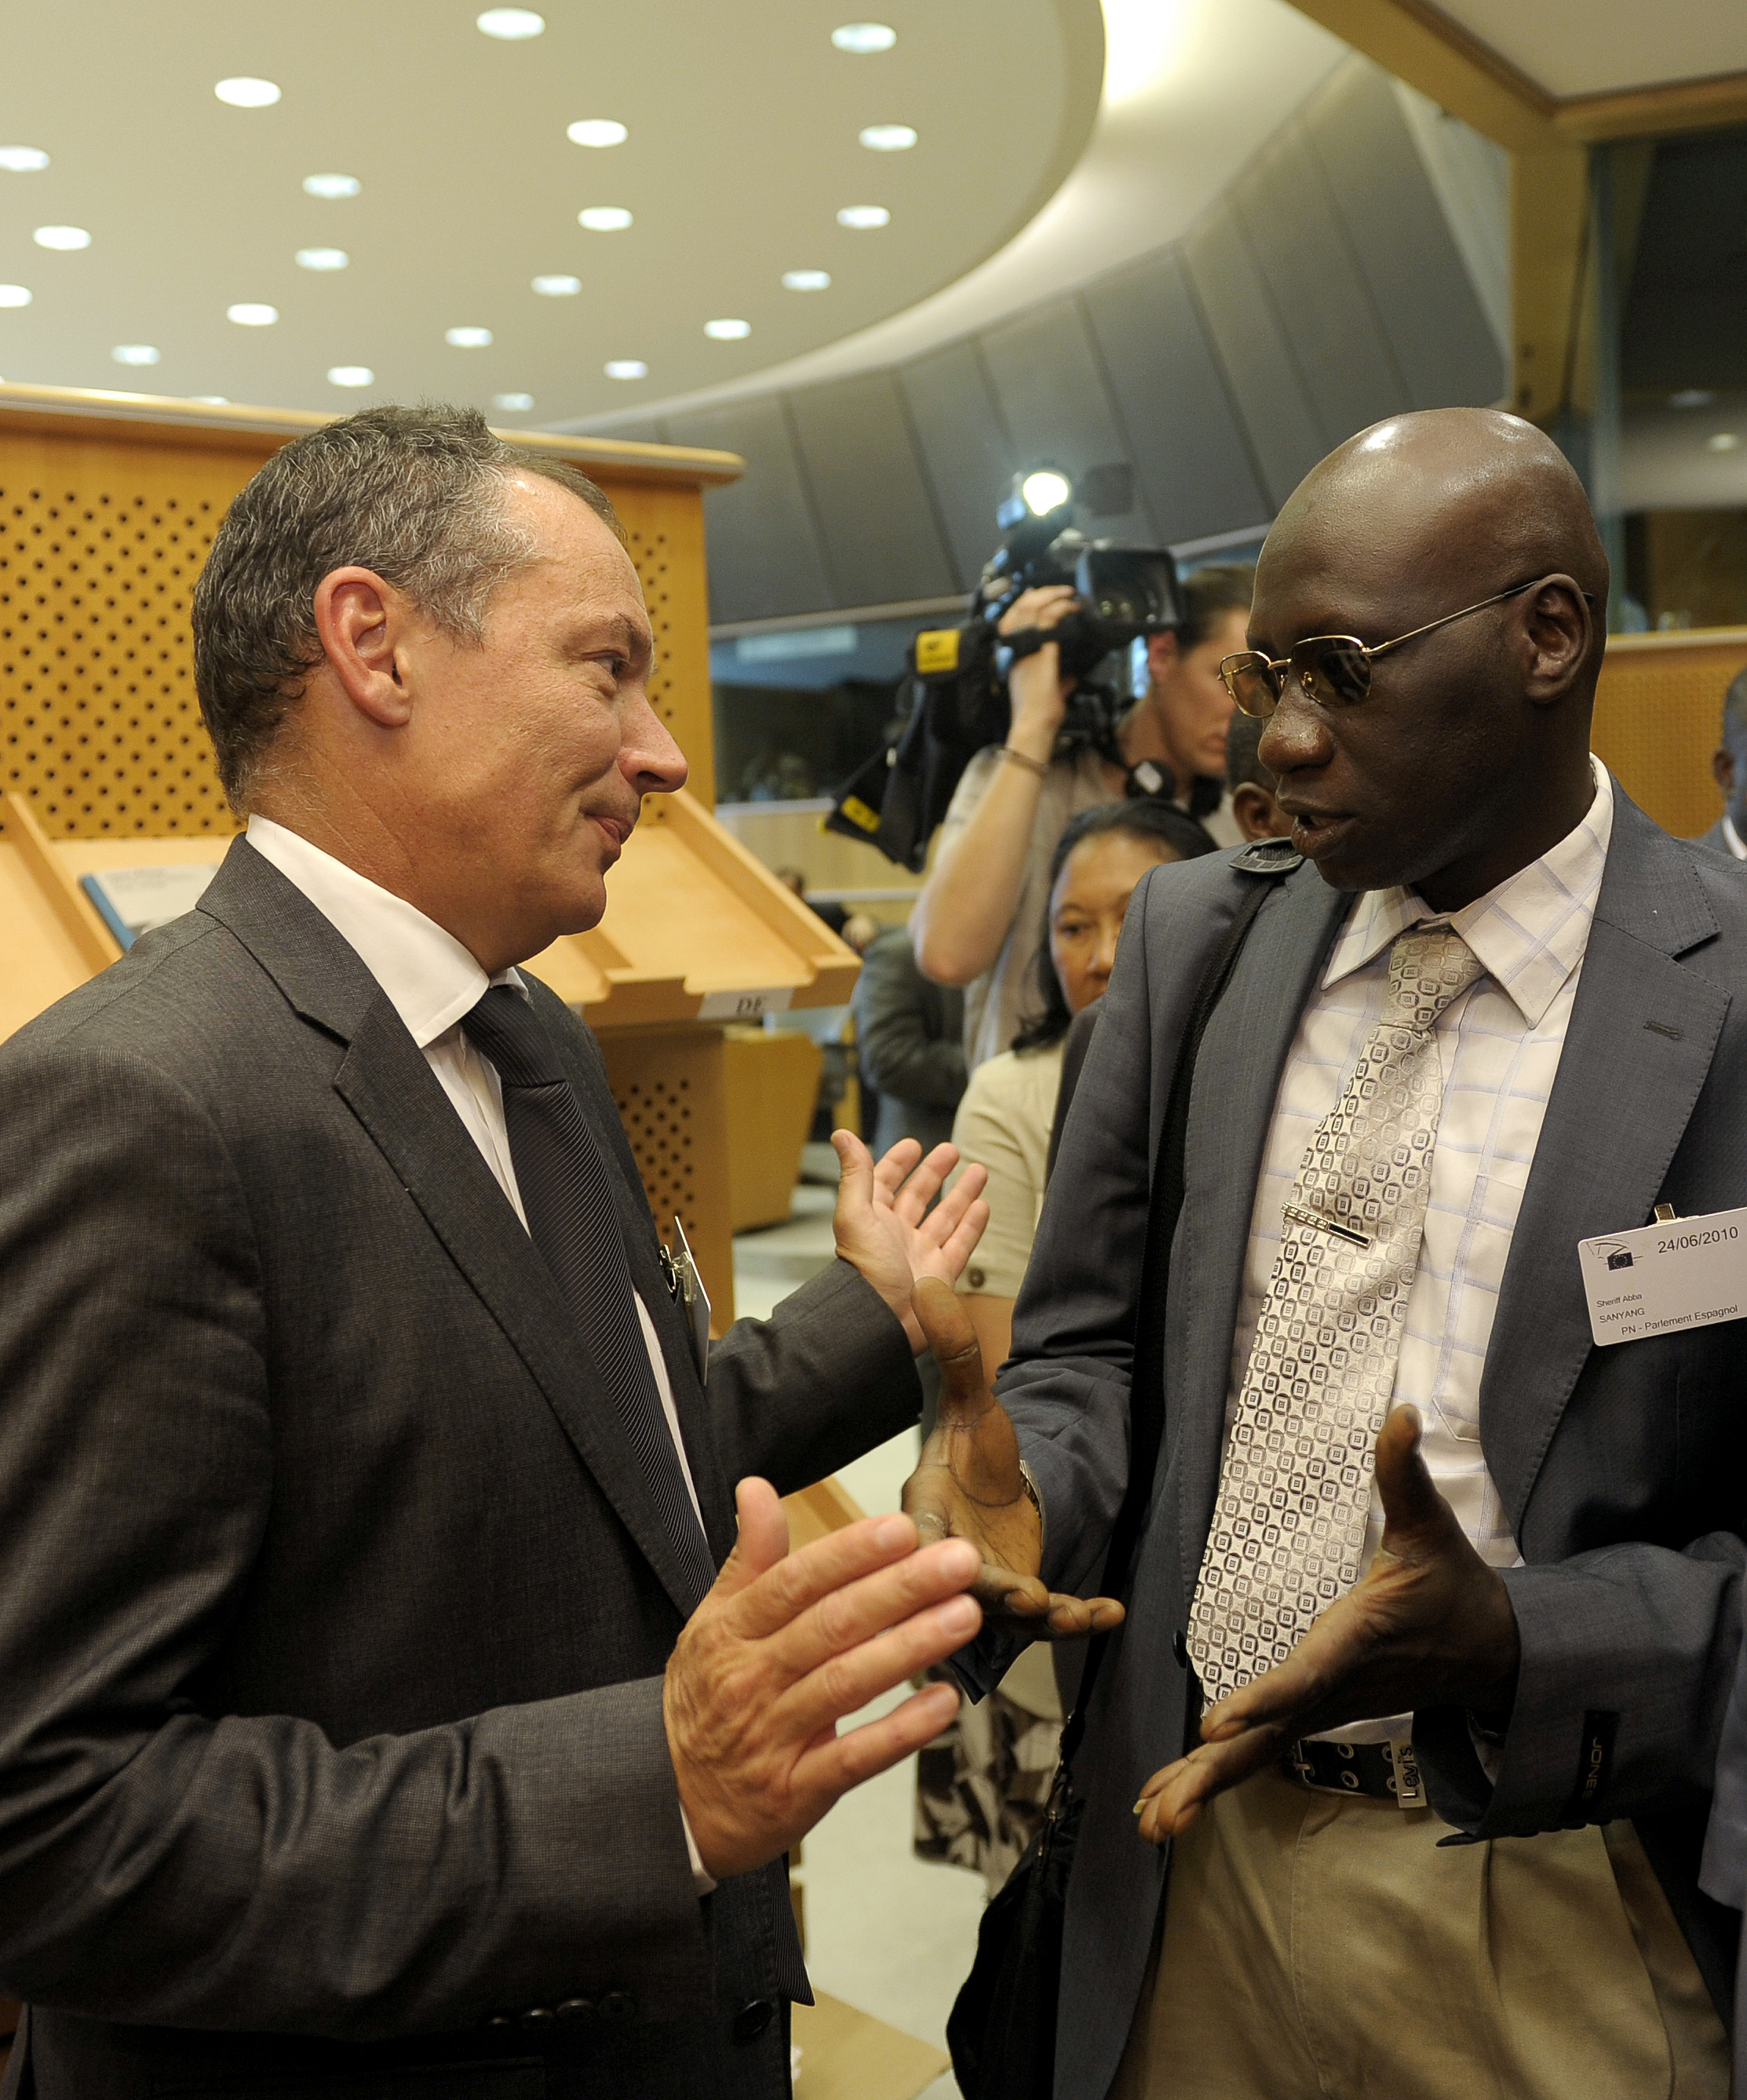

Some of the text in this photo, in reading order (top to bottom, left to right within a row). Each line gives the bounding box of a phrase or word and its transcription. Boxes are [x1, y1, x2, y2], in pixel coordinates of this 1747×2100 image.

[1658, 1227, 1738, 1253] 24/06/2010
[1622, 1294, 1642, 1303] Abba
[1599, 1307, 1645, 1323] SANYANG
[1621, 1325, 1636, 1336] PN
[1644, 1314, 1692, 1331] Parlement
[1694, 1304, 1738, 1320] Espagnol
